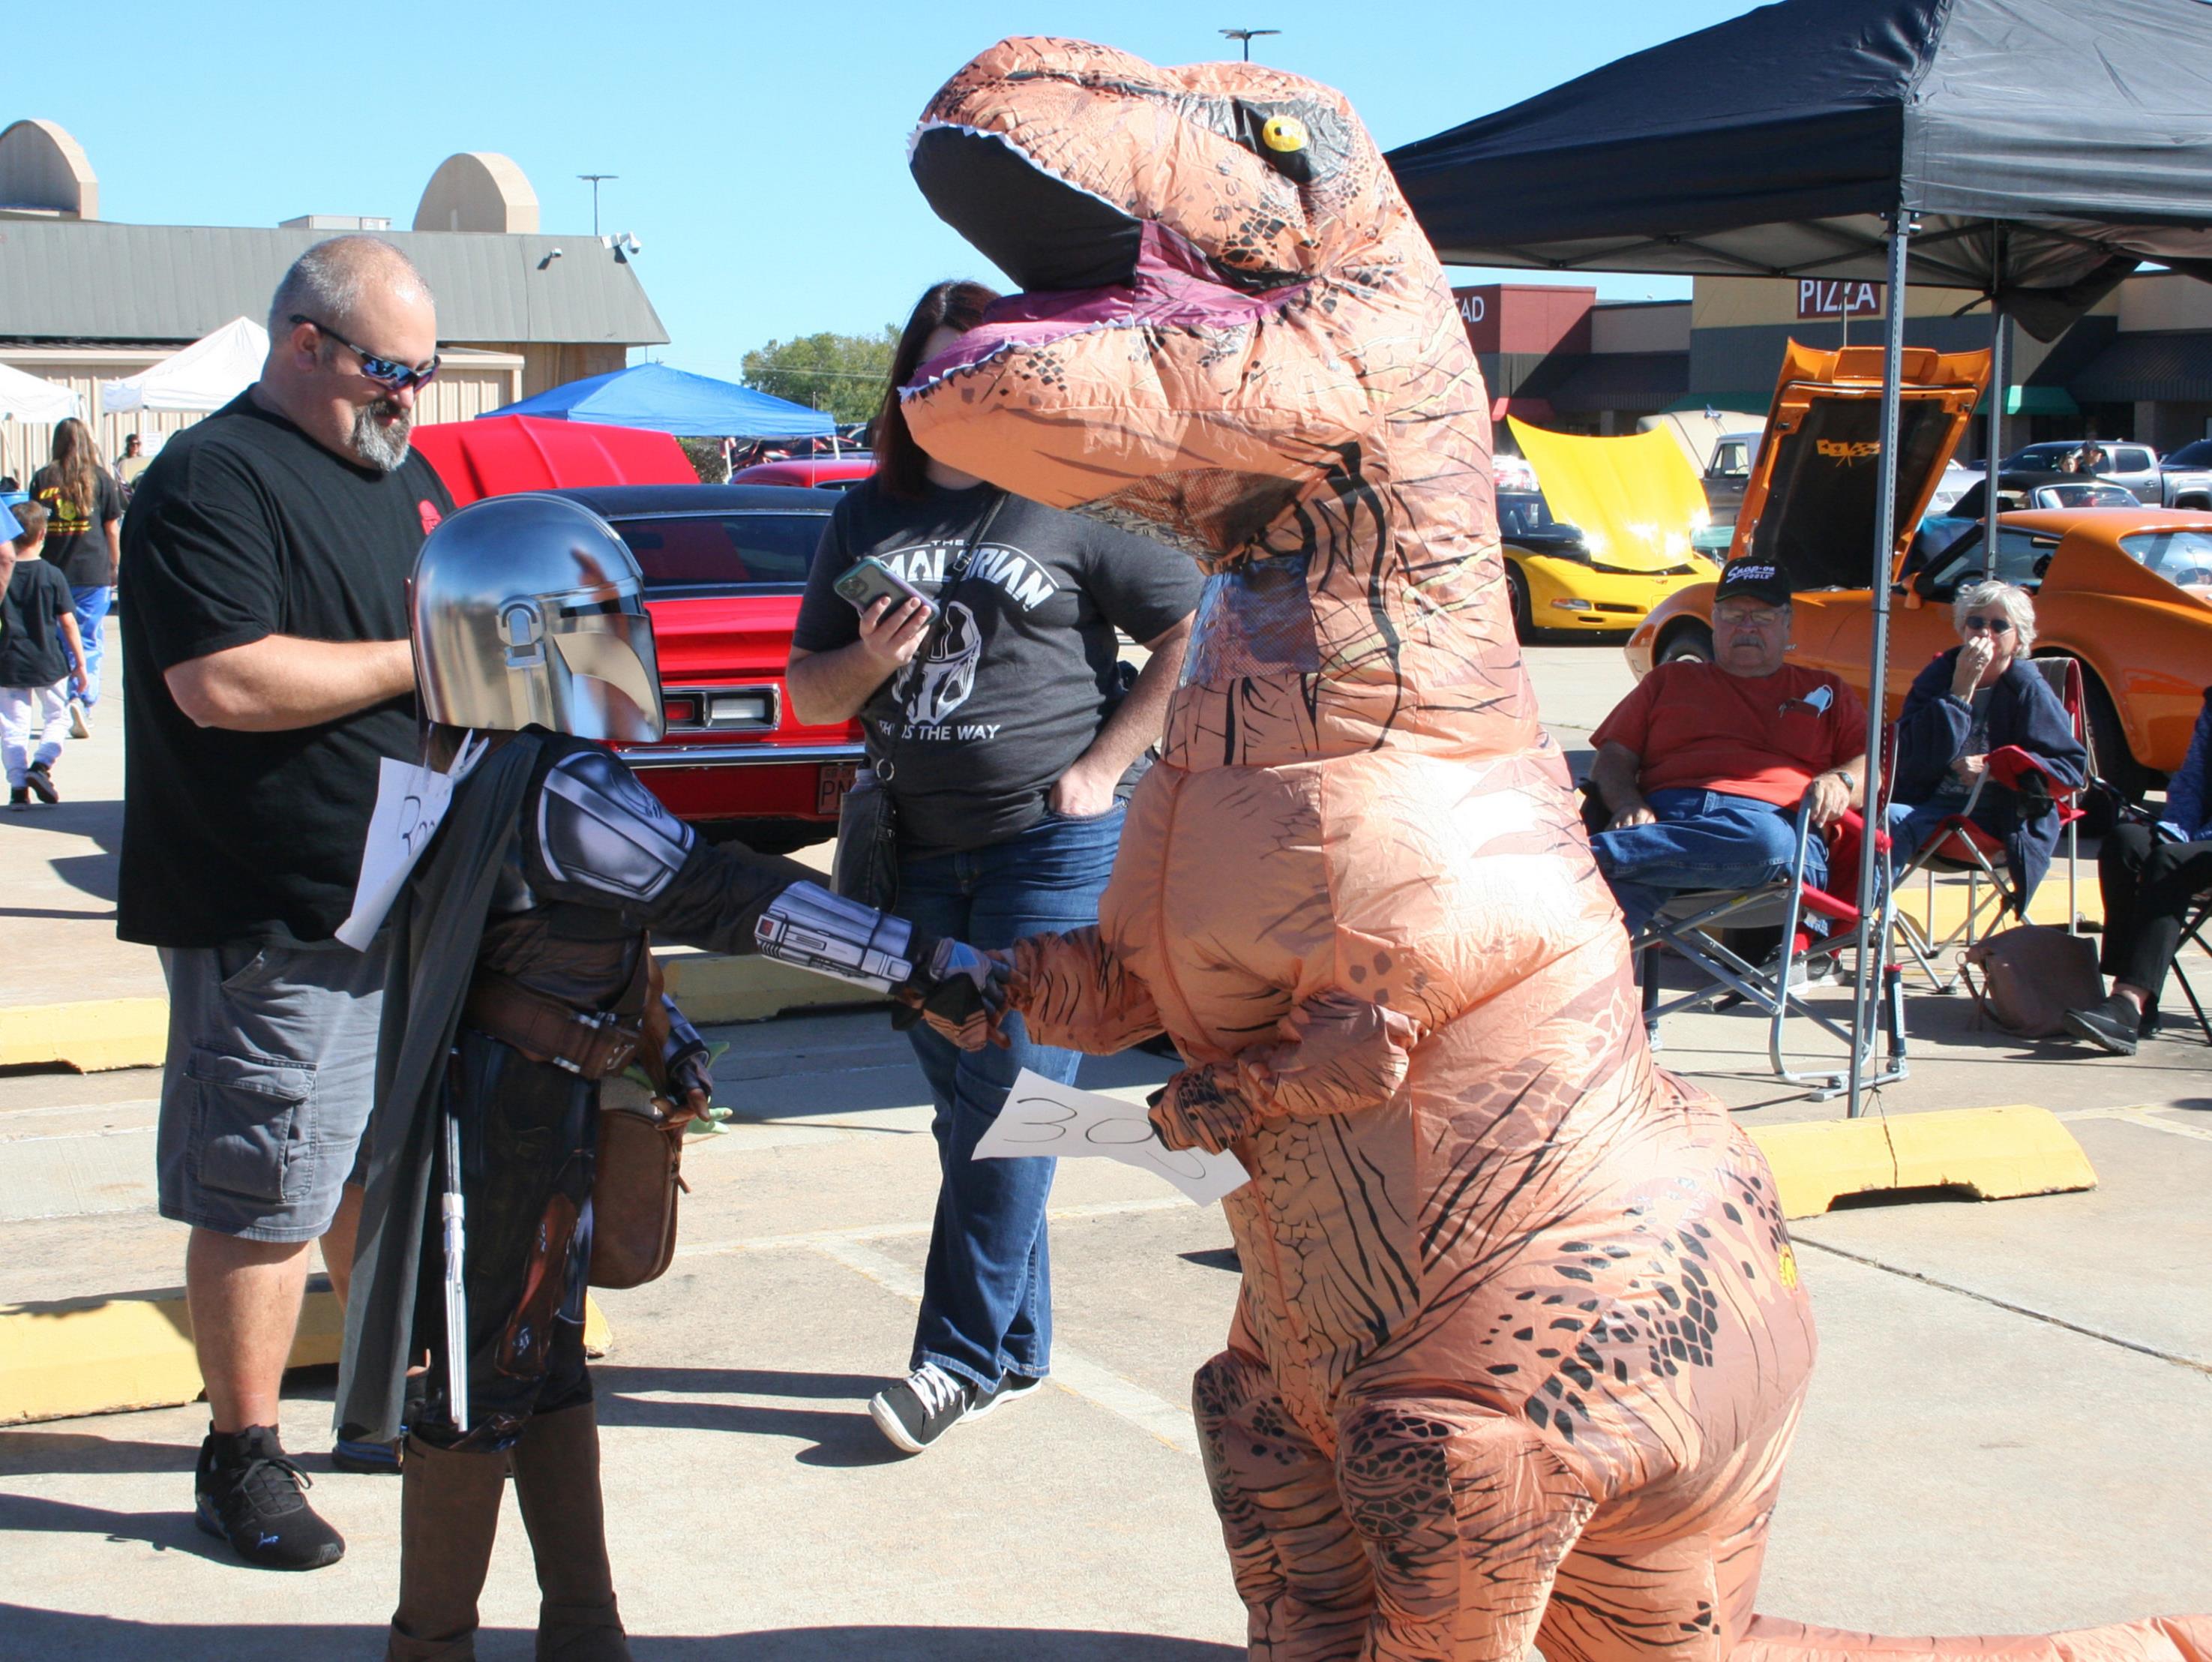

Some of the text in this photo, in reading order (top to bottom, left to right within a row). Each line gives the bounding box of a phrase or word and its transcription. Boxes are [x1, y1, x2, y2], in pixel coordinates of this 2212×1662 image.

[1455, 296, 1484, 323] AD
[1800, 280, 1875, 313] PIZZA
[901, 724, 915, 740] IS
[919, 725, 951, 740] THE
[957, 724, 1001, 740] WAY
